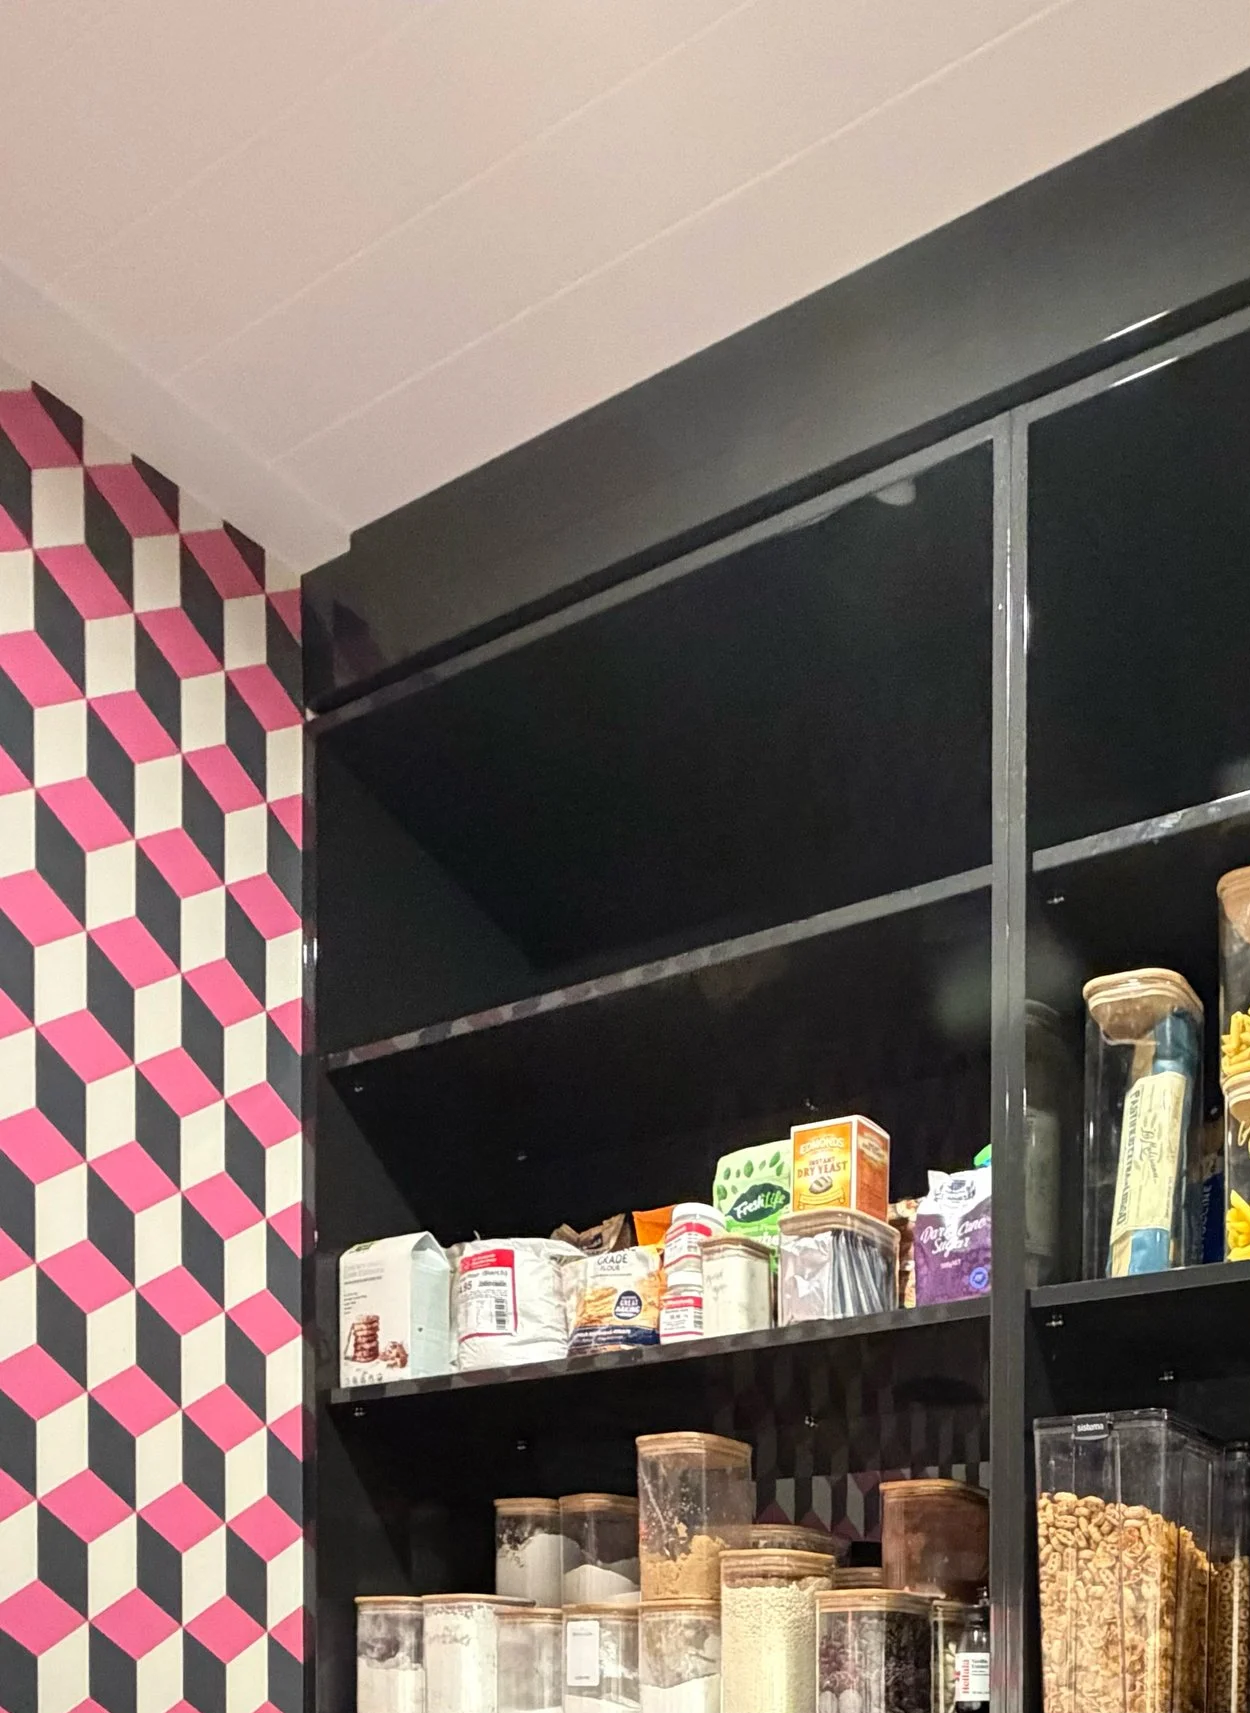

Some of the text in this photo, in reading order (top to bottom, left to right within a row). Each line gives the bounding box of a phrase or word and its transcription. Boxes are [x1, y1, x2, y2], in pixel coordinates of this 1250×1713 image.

[796, 1160, 849, 1179] DRY YEAST
[1077, 1423, 1105, 1432] sistema
